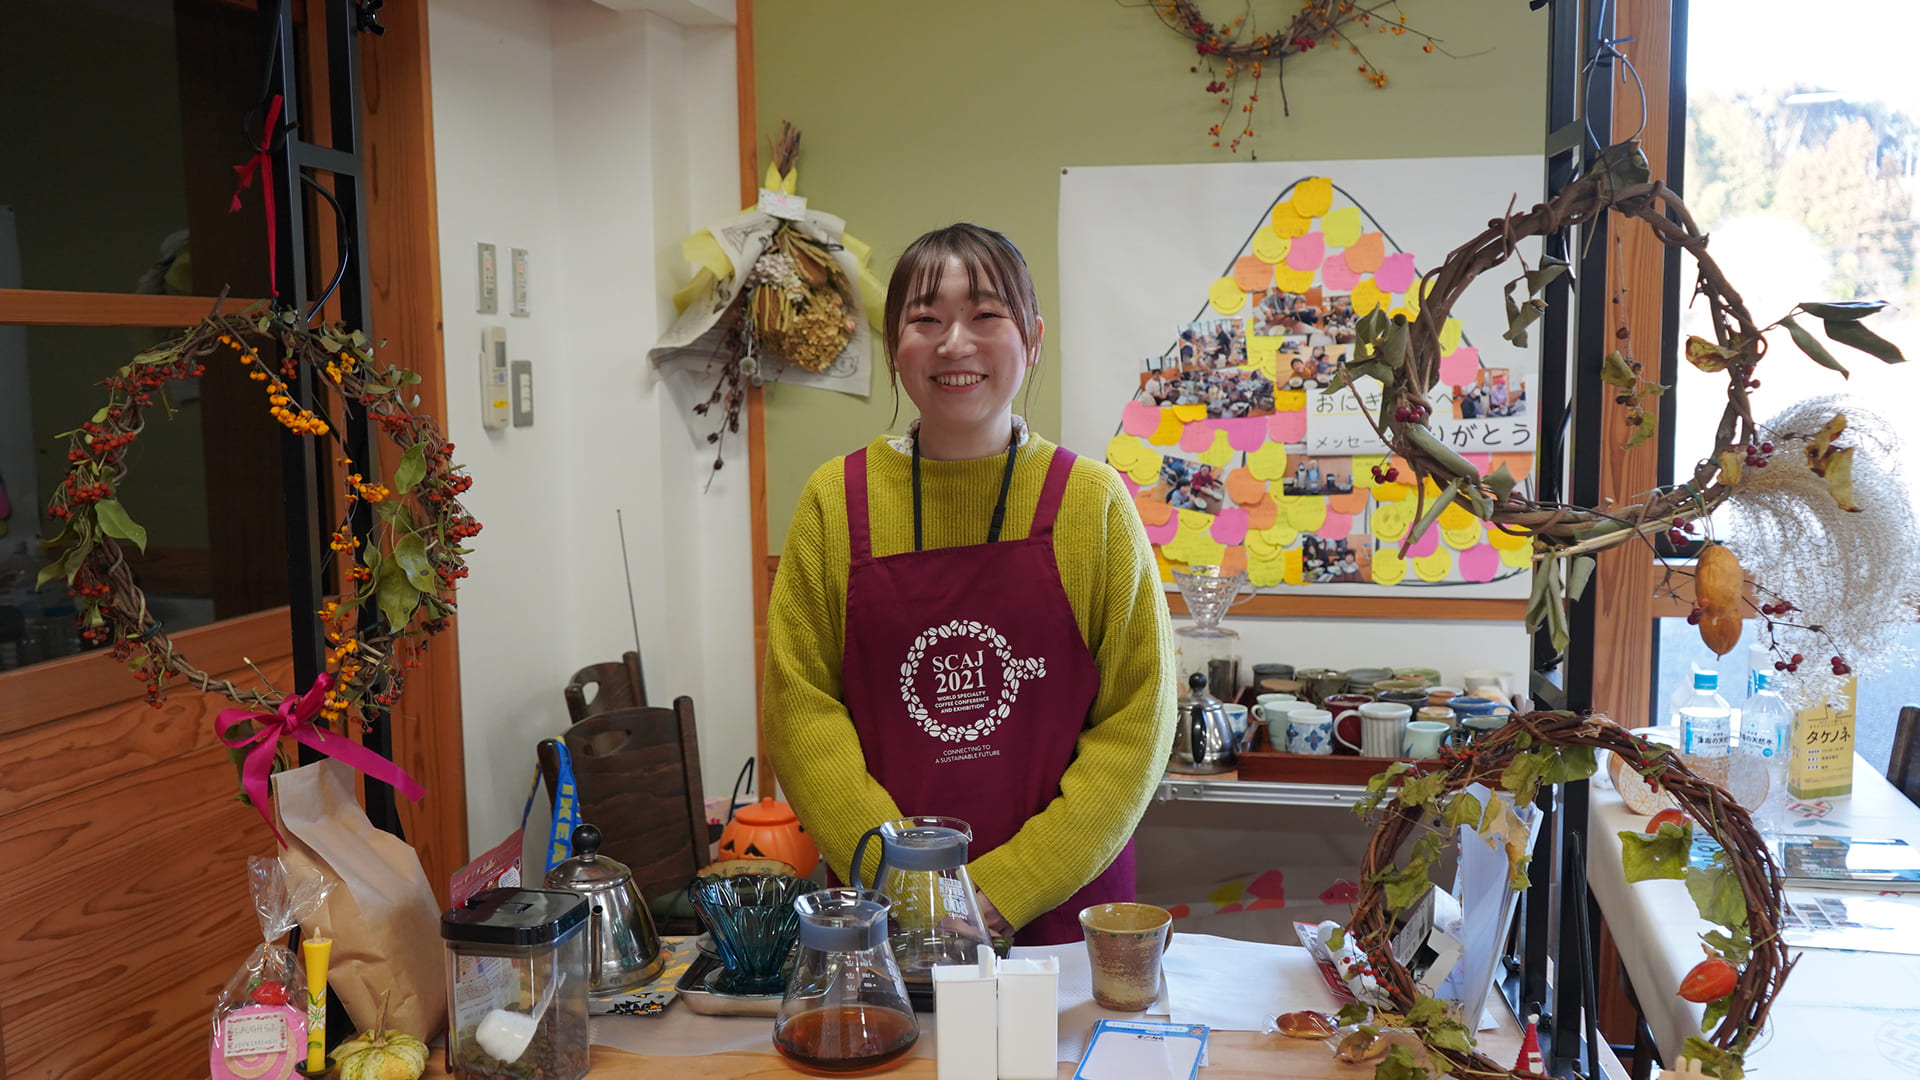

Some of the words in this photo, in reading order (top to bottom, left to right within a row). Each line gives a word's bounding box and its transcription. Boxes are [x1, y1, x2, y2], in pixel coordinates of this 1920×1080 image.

[1316, 392, 1454, 413] おにぎへ
[1429, 423, 1531, 447] りがとう
[932, 650, 984, 673] SCAJ
[934, 668, 987, 694] 2021
[934, 700, 954, 709] COFFEE
[954, 696, 990, 706] CONFERENCE
[936, 693, 957, 702] WORLD
[956, 690, 986, 700] SPECIALTY
[940, 706, 953, 714] AND
[953, 703, 985, 713] EXHIBITION
[1807, 726, 1851, 745] タケノネ
[940, 753, 978, 764] SUSTAINABLE
[978, 750, 1000, 759] FUTURE
[943, 745, 981, 756] CONNECTING
[552, 783, 574, 864] IKEA
[235, 1023, 263, 1035] LAUGH
